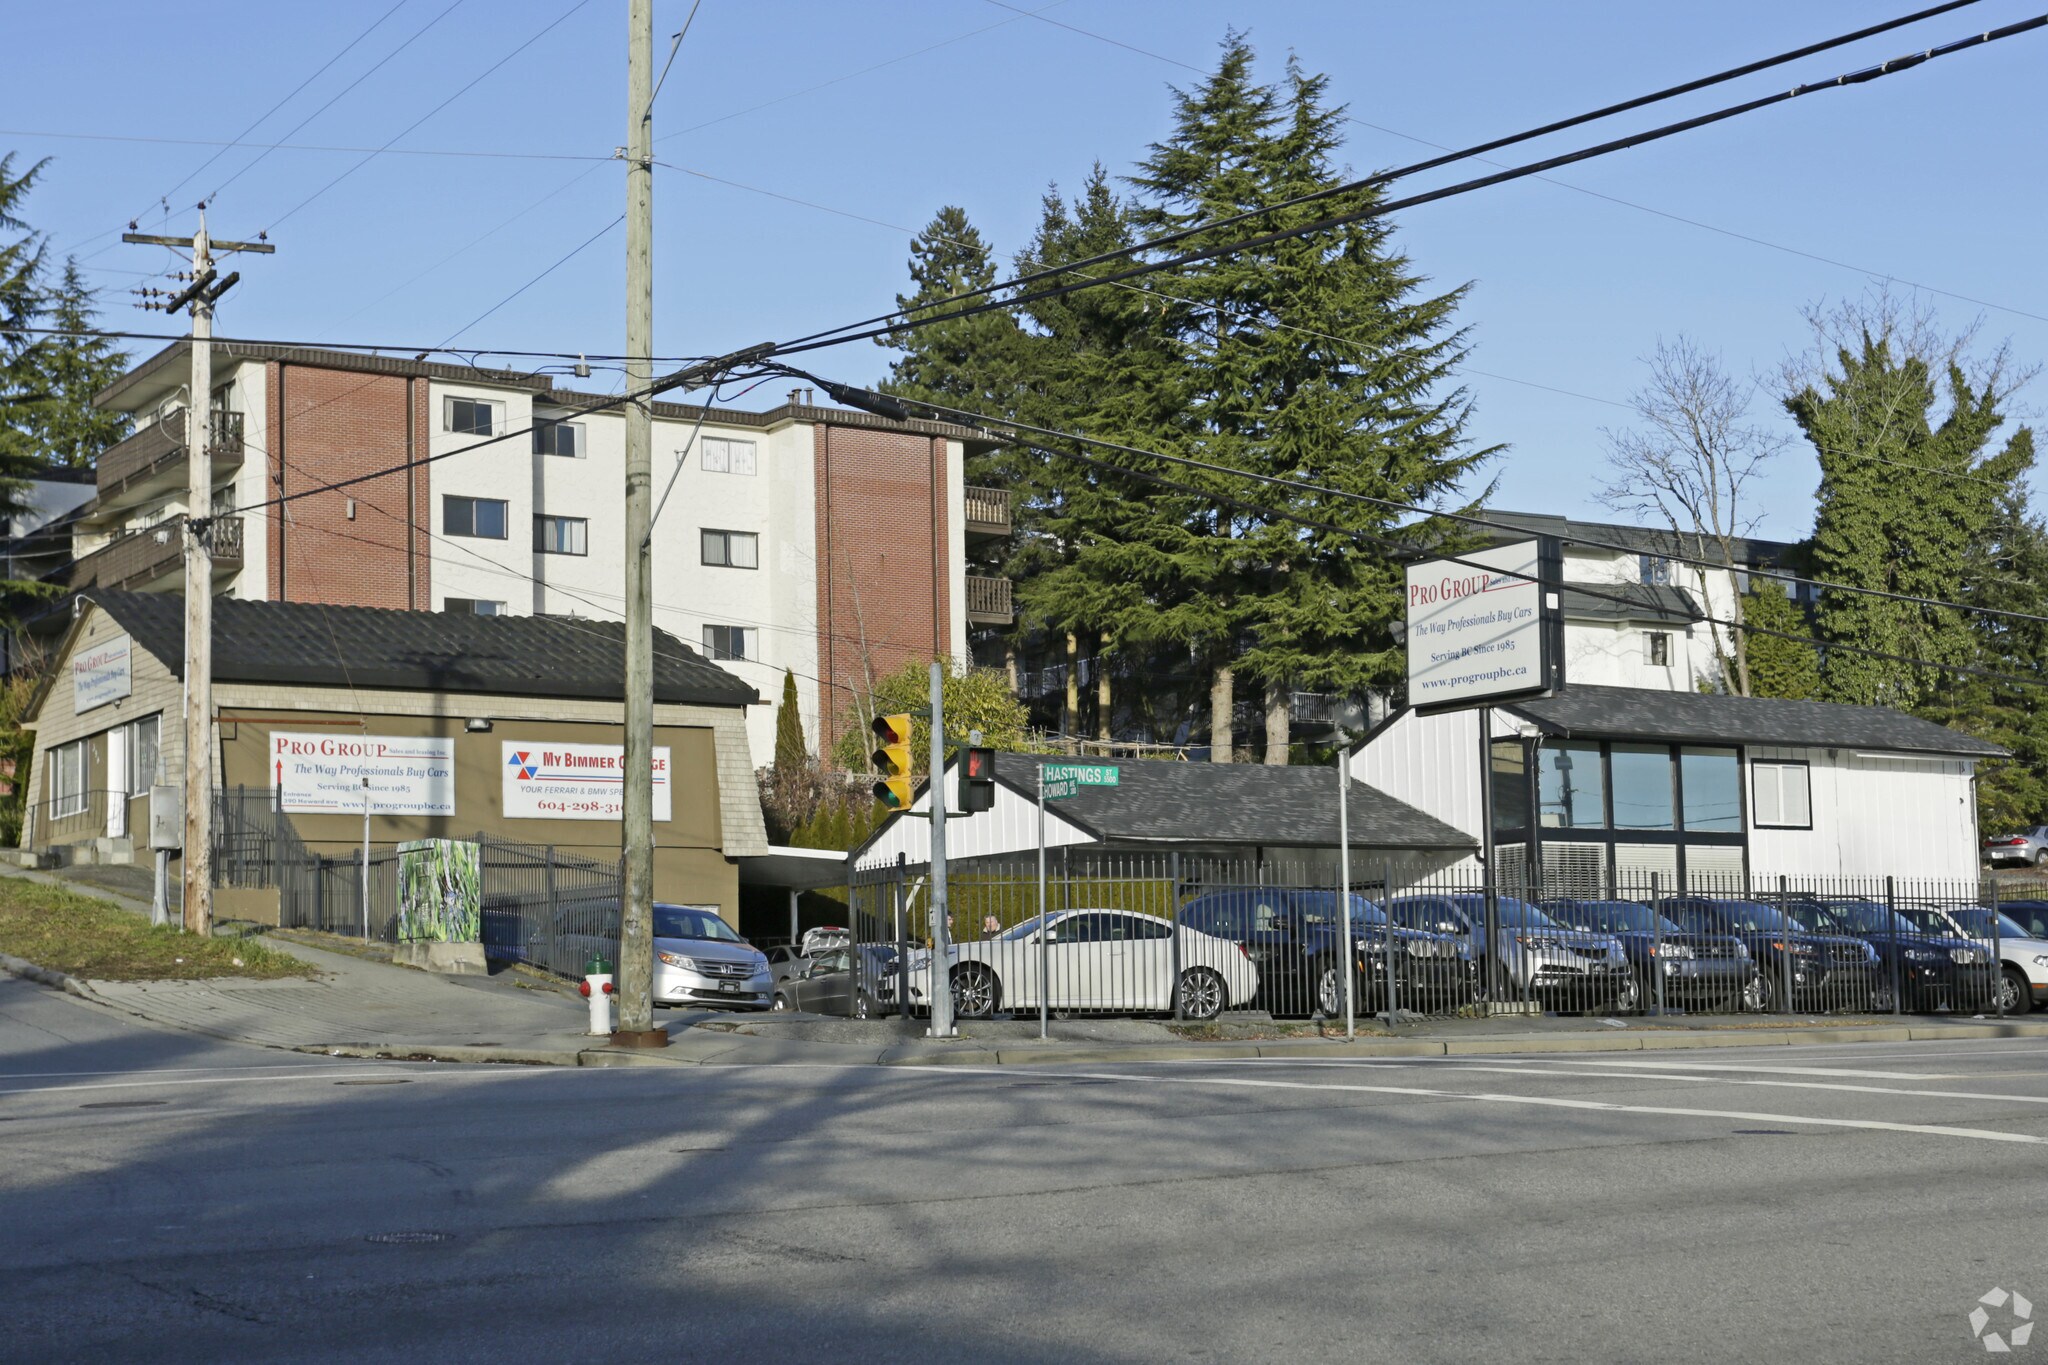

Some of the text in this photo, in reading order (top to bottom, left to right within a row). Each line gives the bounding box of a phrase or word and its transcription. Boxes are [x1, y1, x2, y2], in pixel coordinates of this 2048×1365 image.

[1410, 574, 1490, 607] PRO GROUP
[1416, 606, 1532, 637] The Way Professionals Buy Cars
[1431, 640, 1516, 662] Serving BC Since 1985
[1422, 666, 1527, 689] www.progroupbc.ca
[276, 737, 387, 758] PRO GROUP
[564, 752, 615, 769] BIMMER
[295, 763, 449, 779] The Way Professionals Buy Cars
[1046, 767, 1102, 783] HASTINGS
[317, 783, 350, 792] Serving
[367, 784, 390, 792] Since
[392, 785, 411, 793] 1985
[521, 785, 543, 794] YOUR
[545, 786, 578, 794] FERRARI
[587, 787, 608, 796] BMW
[1044, 781, 1068, 799] HOWARD
[538, 799, 625, 814] 604-298-31
